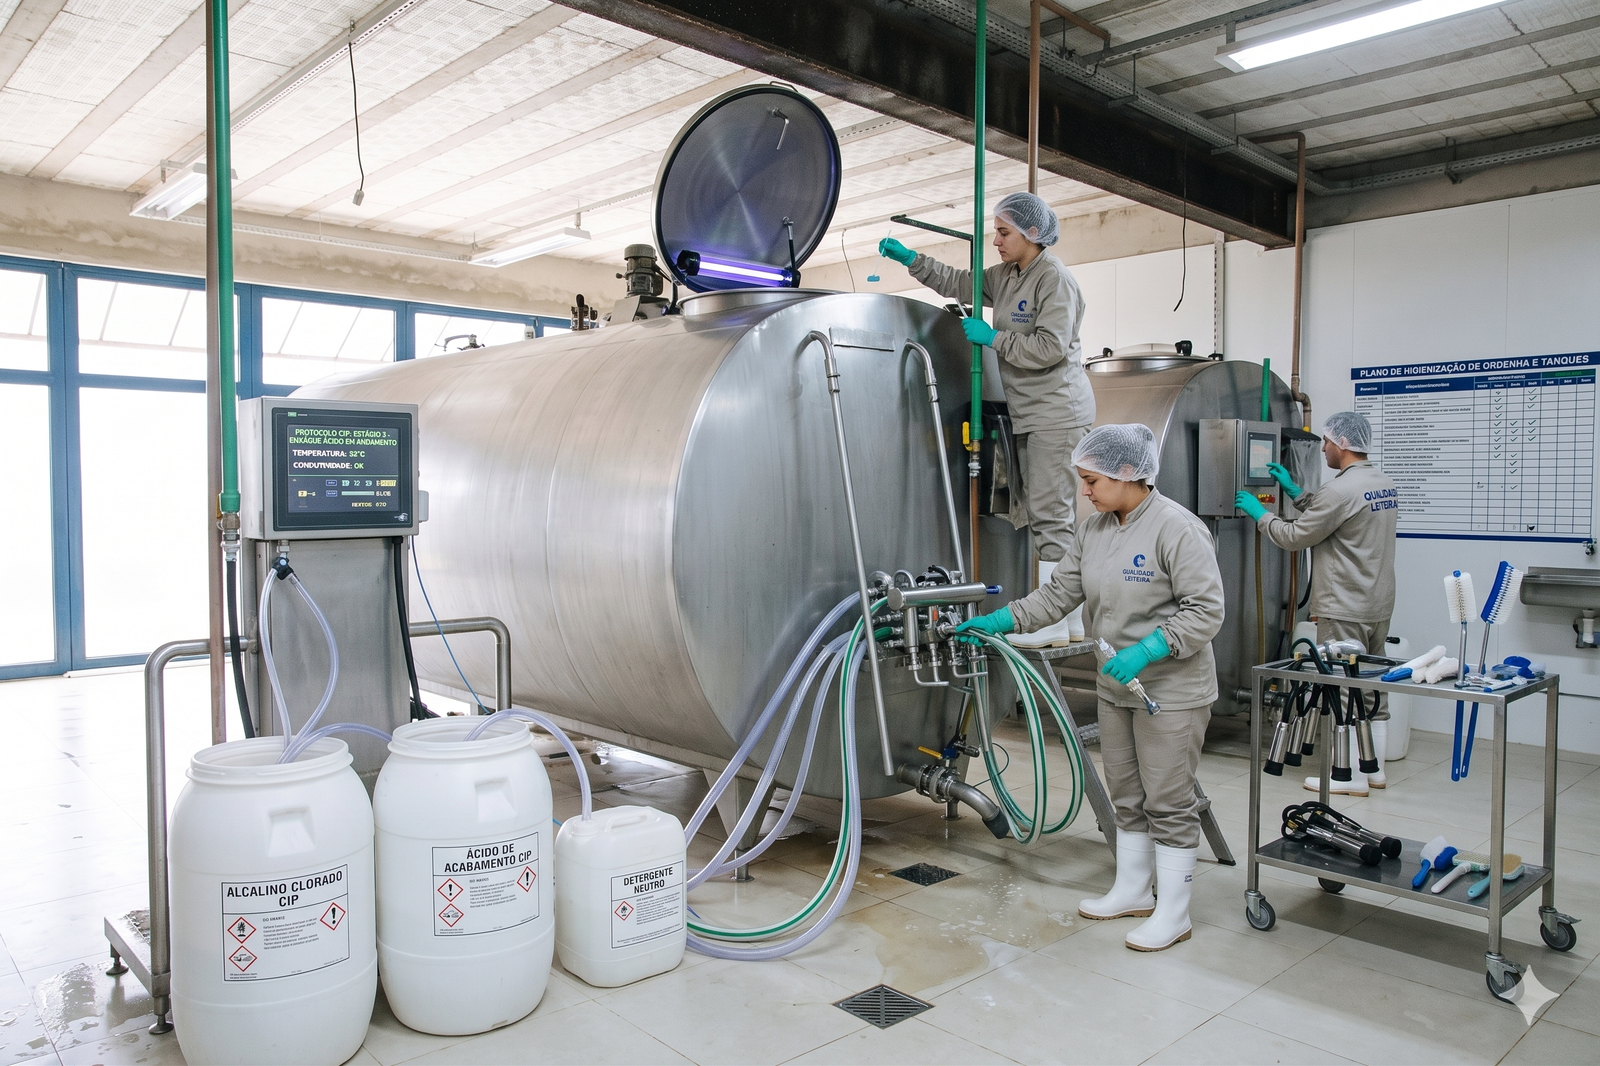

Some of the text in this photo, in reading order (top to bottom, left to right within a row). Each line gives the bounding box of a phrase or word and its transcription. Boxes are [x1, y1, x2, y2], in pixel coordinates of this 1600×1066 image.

[1360, 355, 1589, 377] PLANO DE HIGIENIZAÇÃO DE ORDENHA E TANQUES
[289, 436, 321, 445] ENXÁGUE
[323, 436, 344, 445] ÁCIDO
[356, 438, 397, 446] ANDAMENTO
[295, 429, 338, 437] PROTOCOLO
[353, 430, 381, 438] ESTÁGIO
[292, 449, 347, 457] TEMPERATURA:
[466, 843, 514, 860] ÁCIDO DE
[444, 850, 532, 873] ACABAMENTO CIP
[226, 870, 343, 898] ALCALINO CLORADO
[624, 866, 673, 886] DETERGENTE
[634, 879, 665, 894] NEUTRO
[278, 894, 299, 907] CIP
